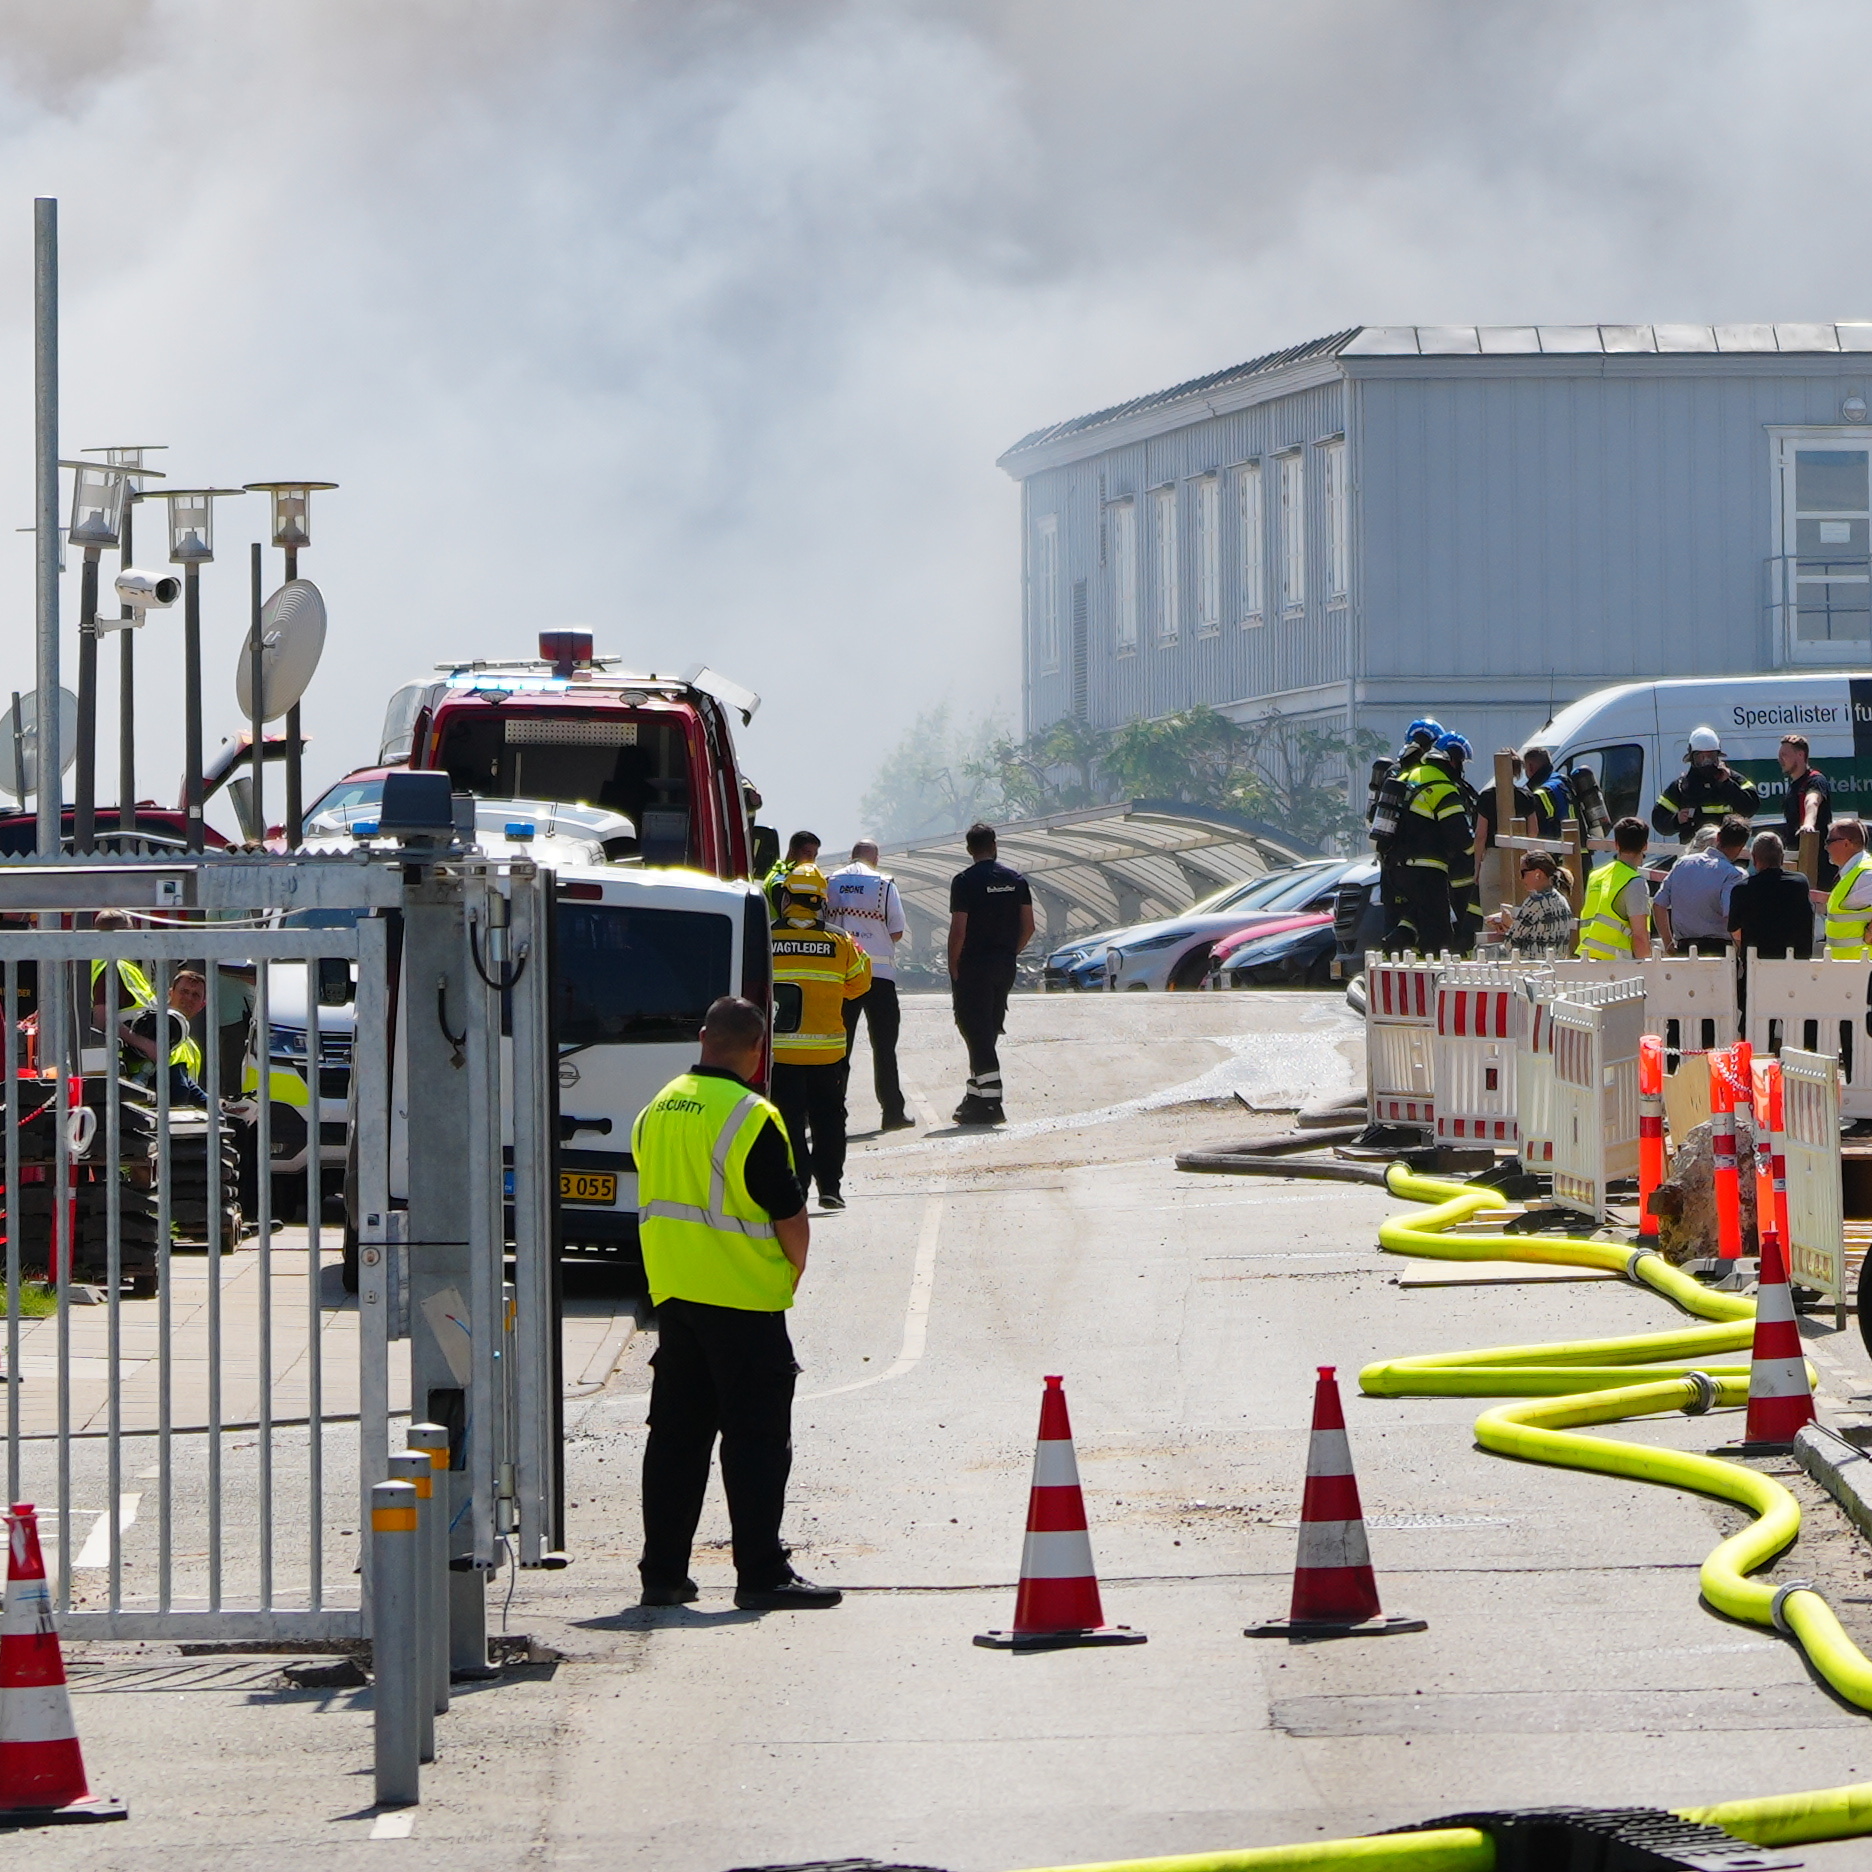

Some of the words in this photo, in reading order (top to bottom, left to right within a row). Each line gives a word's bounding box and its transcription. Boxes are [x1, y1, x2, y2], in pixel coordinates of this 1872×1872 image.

[1733, 704, 1837, 728] Specialister
[1844, 703, 1849, 722] i
[839, 885, 865, 895] DRONE
[771, 940, 831, 955] VAGTLEDER
[577, 1177, 612, 1197] 055
